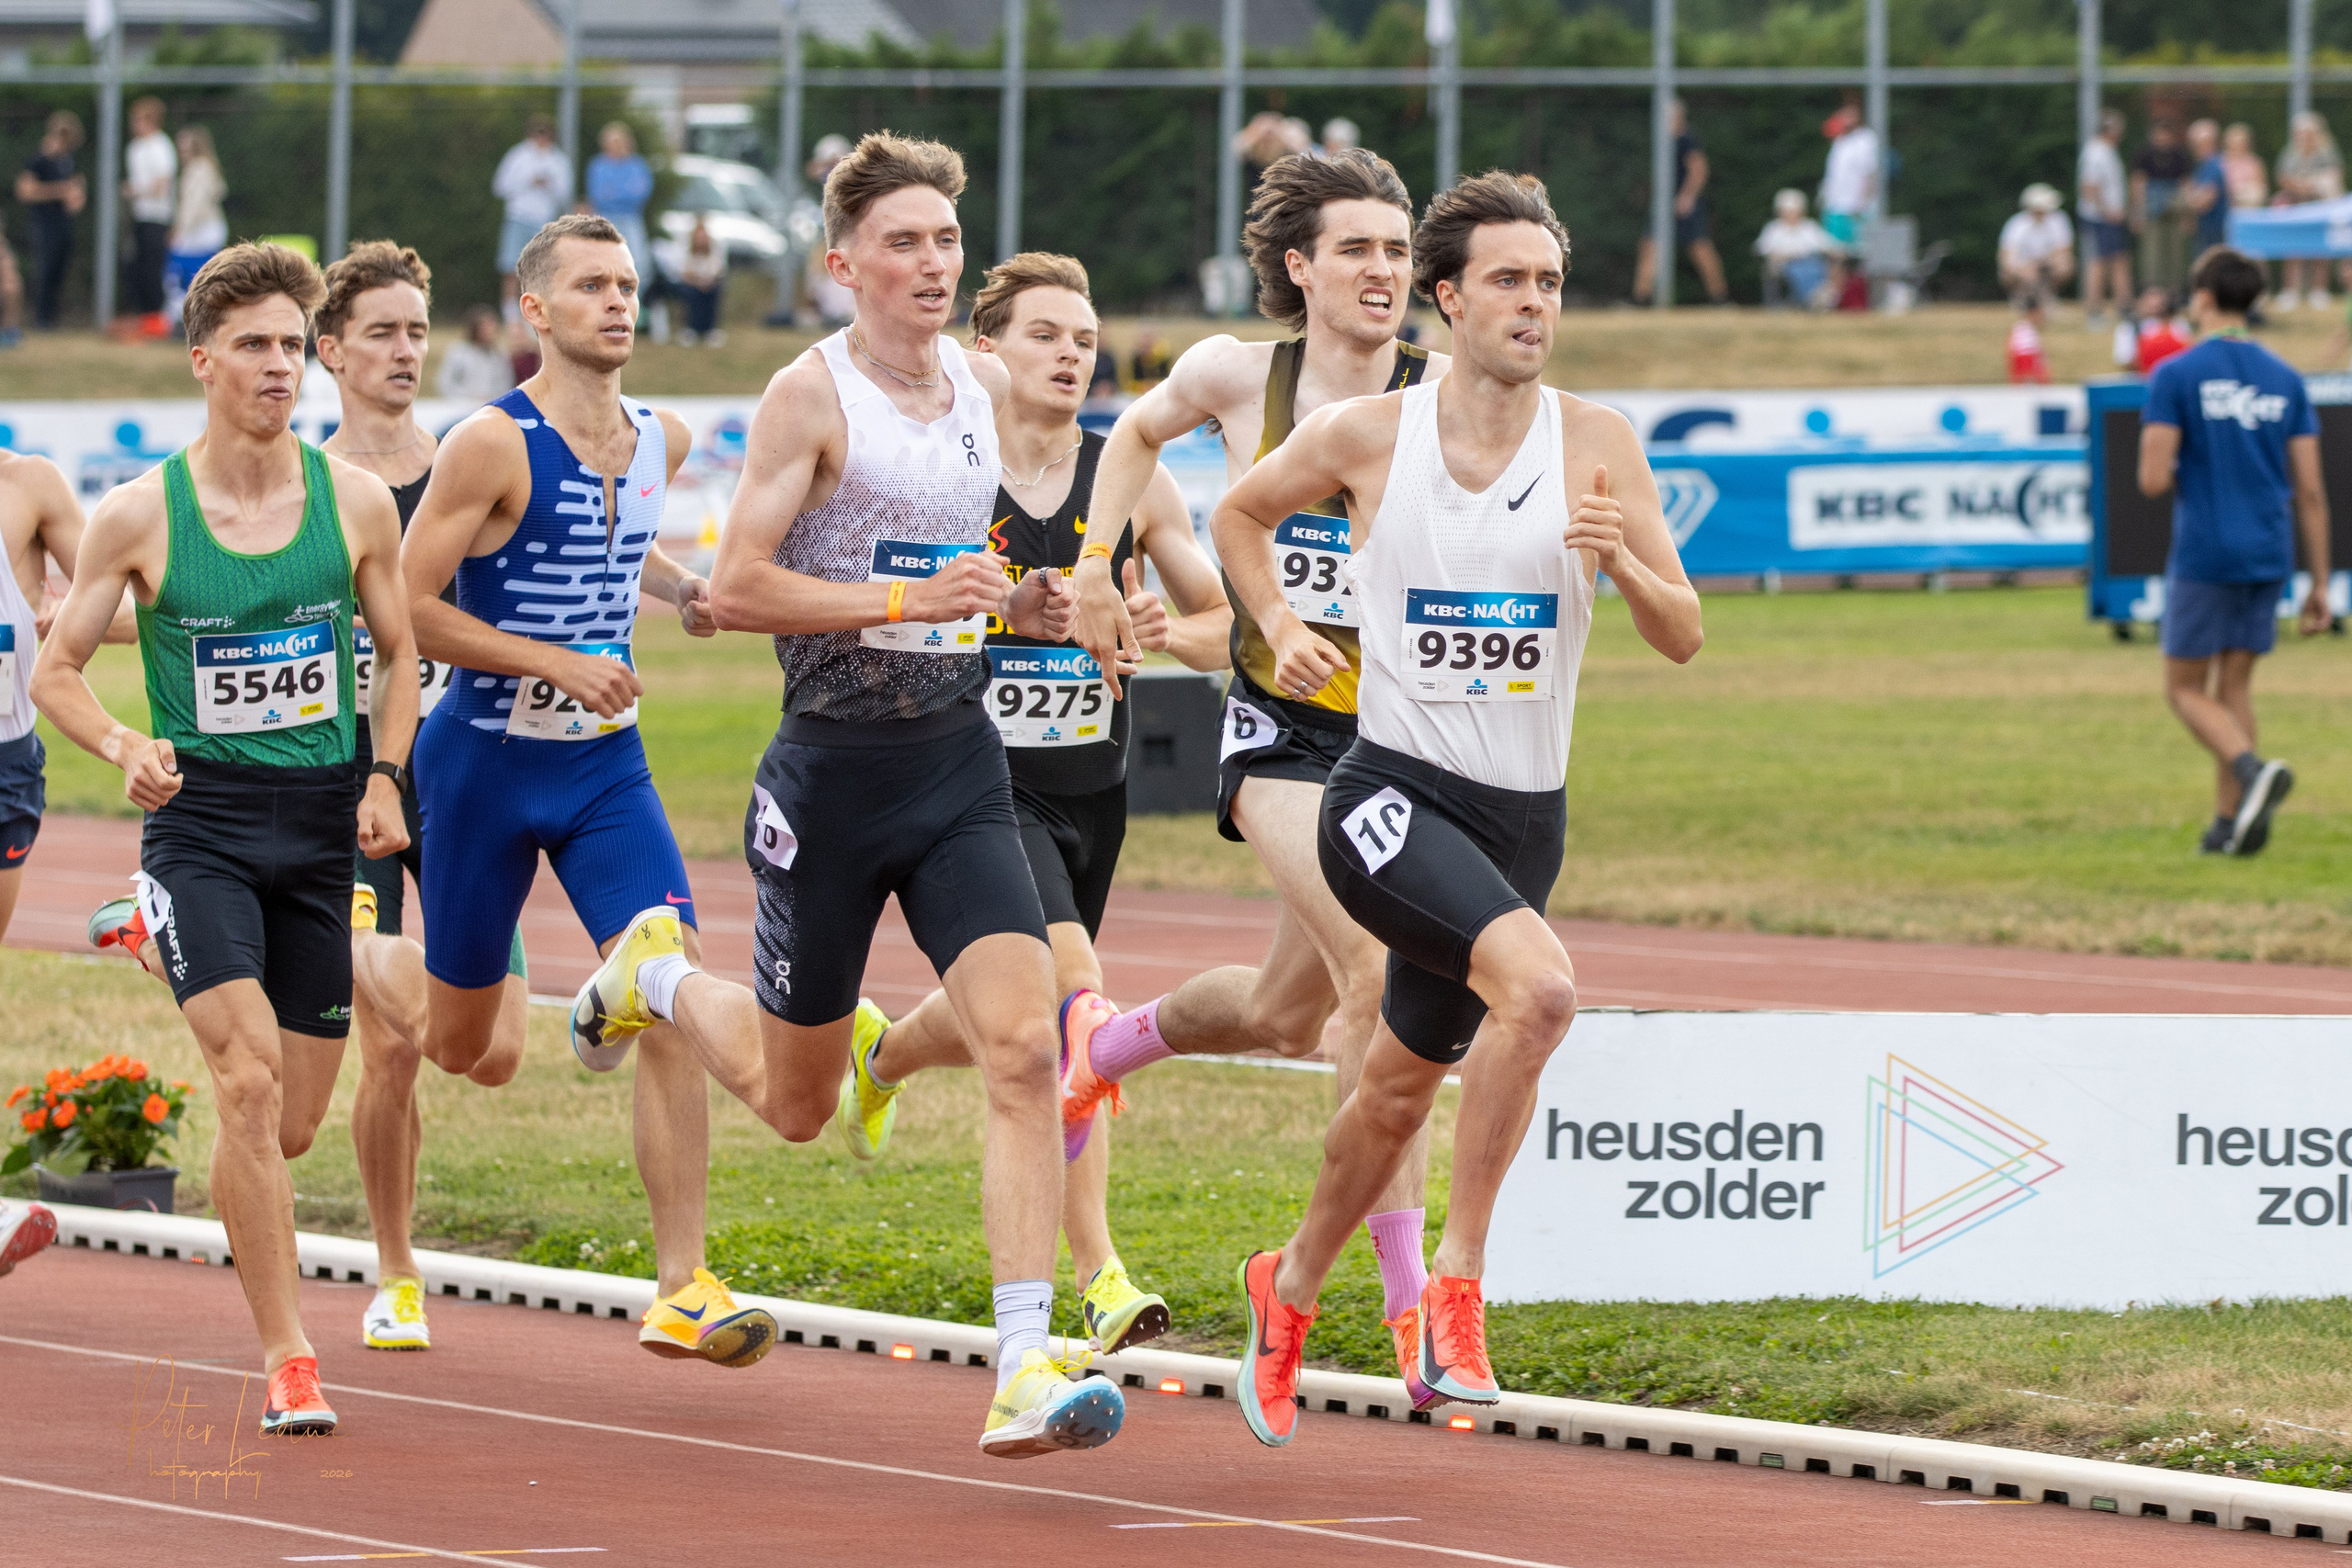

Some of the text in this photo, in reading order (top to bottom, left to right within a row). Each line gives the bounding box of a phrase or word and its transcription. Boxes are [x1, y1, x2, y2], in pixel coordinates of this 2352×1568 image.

[1815, 490, 1924, 522] KBC
[1283, 551, 1352, 596] 93
[180, 617, 222, 627] CRAFT
[1323, 611, 1343, 620] KBC
[1418, 630, 1541, 671] 9396
[213, 660, 324, 705] 5546
[356, 659, 455, 691] 99
[529, 679, 625, 714] 92
[997, 683, 1103, 718] 9275
[262, 716, 282, 726] KBC
[1232, 706, 1258, 740] 6
[1546, 1108, 1824, 1162] heusden
[1625, 1168, 1826, 1221] zolder
[2257, 1173, 2352, 1226] zol
